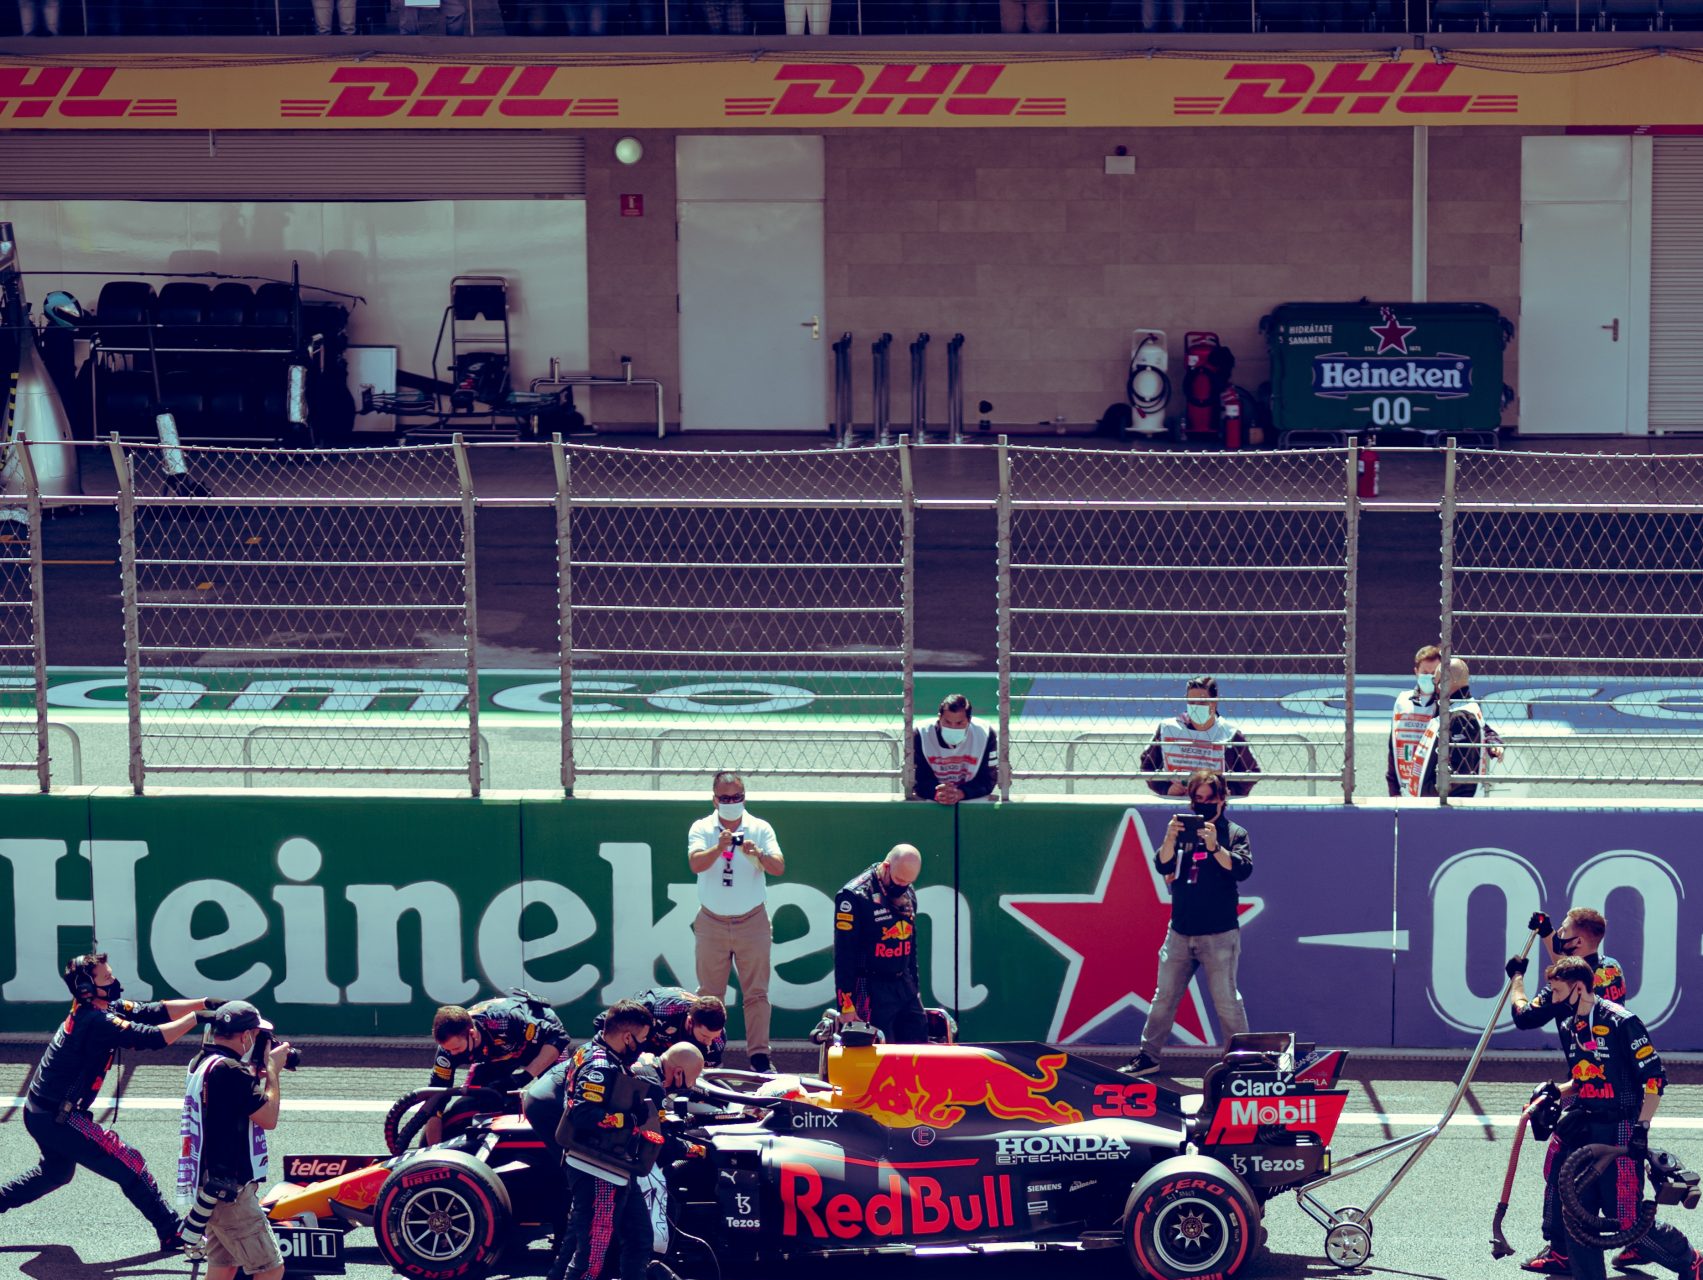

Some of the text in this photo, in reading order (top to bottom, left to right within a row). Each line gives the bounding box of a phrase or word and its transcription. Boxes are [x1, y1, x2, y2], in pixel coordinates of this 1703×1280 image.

[0, 66, 133, 118] HL
[326, 66, 577, 118] DHL
[771, 64, 1020, 116] DHL
[1220, 62, 1472, 115] DHL
[1321, 362, 1462, 388] Heineken
[1373, 397, 1411, 426] 0.0
[2, 837, 988, 1010] Heineken
[1093, 1083, 1157, 1117] 33
[1231, 1079, 1287, 1097] Claro
[792, 1110, 838, 1128] citrix
[1231, 1099, 1316, 1126] Mobil
[996, 1134, 1130, 1155] HONDA
[290, 1159, 347, 1176] telcel
[1251, 1156, 1305, 1172] Tezos
[402, 1166, 451, 1188] PIRELLI
[1027, 1183, 1062, 1193] SIEMENS
[1161, 1179, 1225, 1196] ZERO
[726, 1217, 760, 1228] Tezos
[275, 1232, 307, 1257] bil
